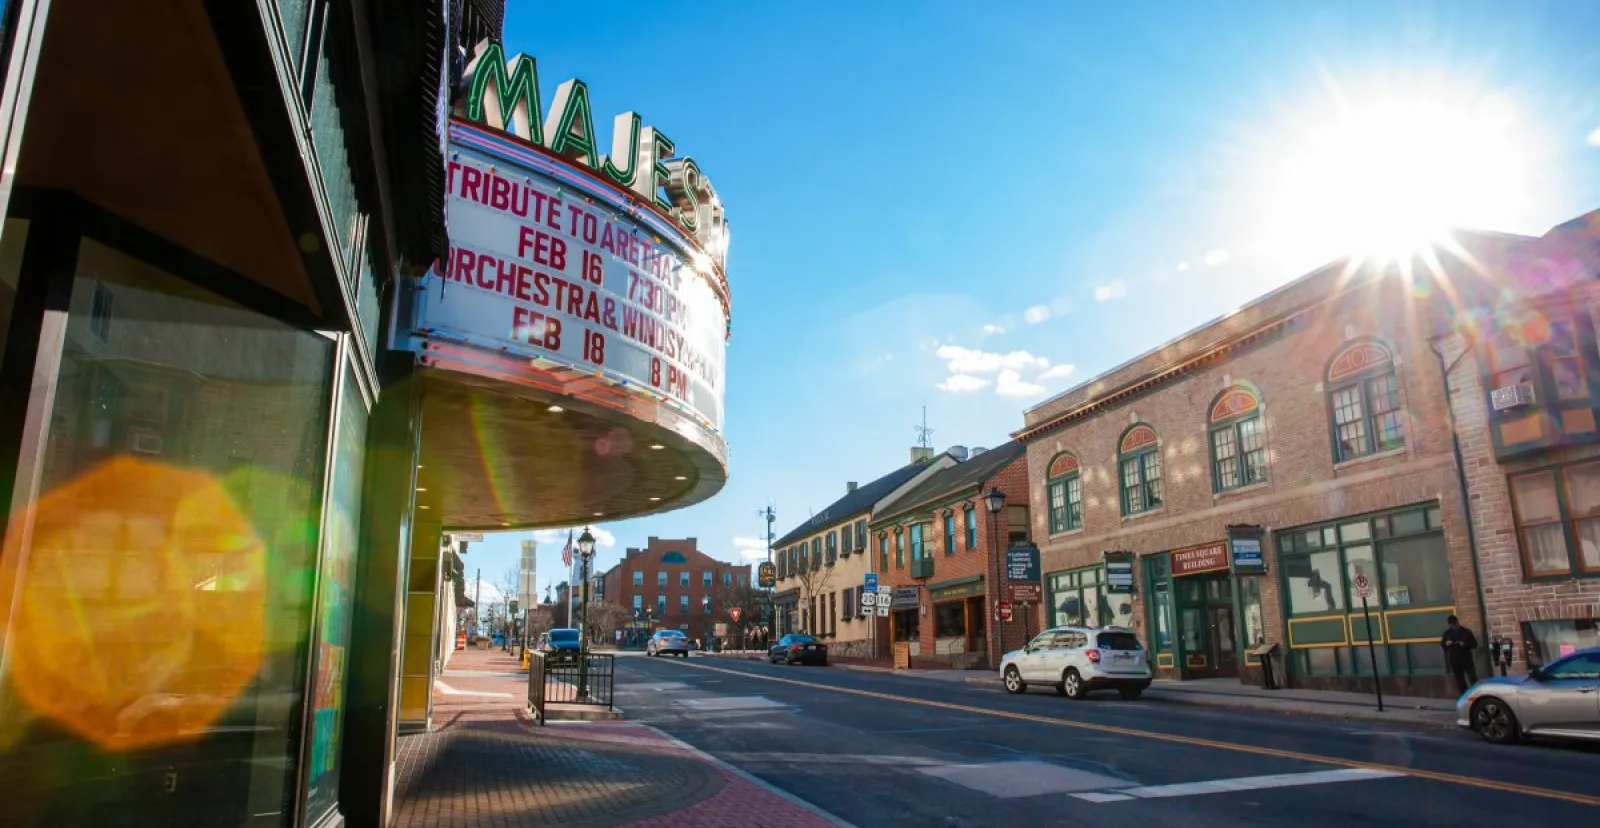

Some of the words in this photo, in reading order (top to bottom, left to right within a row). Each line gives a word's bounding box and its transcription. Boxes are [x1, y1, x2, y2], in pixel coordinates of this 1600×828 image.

[448, 162, 562, 231] TRIBUTE
[568, 203, 597, 246] TO
[600, 219, 672, 287] ARETHA
[431, 244, 600, 324] ORCHESTRA
[602, 297, 618, 332] &
[622, 303, 665, 352] WIND
[518, 225, 567, 271] FEB
[581, 249, 603, 286] 16
[627, 269, 663, 315] 7:30
[511, 305, 562, 351] FEB
[583, 327, 605, 366] 18
[651, 356, 661, 388] 8
[667, 364, 688, 401] PM
[1183, 557, 1216, 570] BUILDING
[1195, 545, 1223, 558] SQUARE
[876, 596, 890, 605] 116
